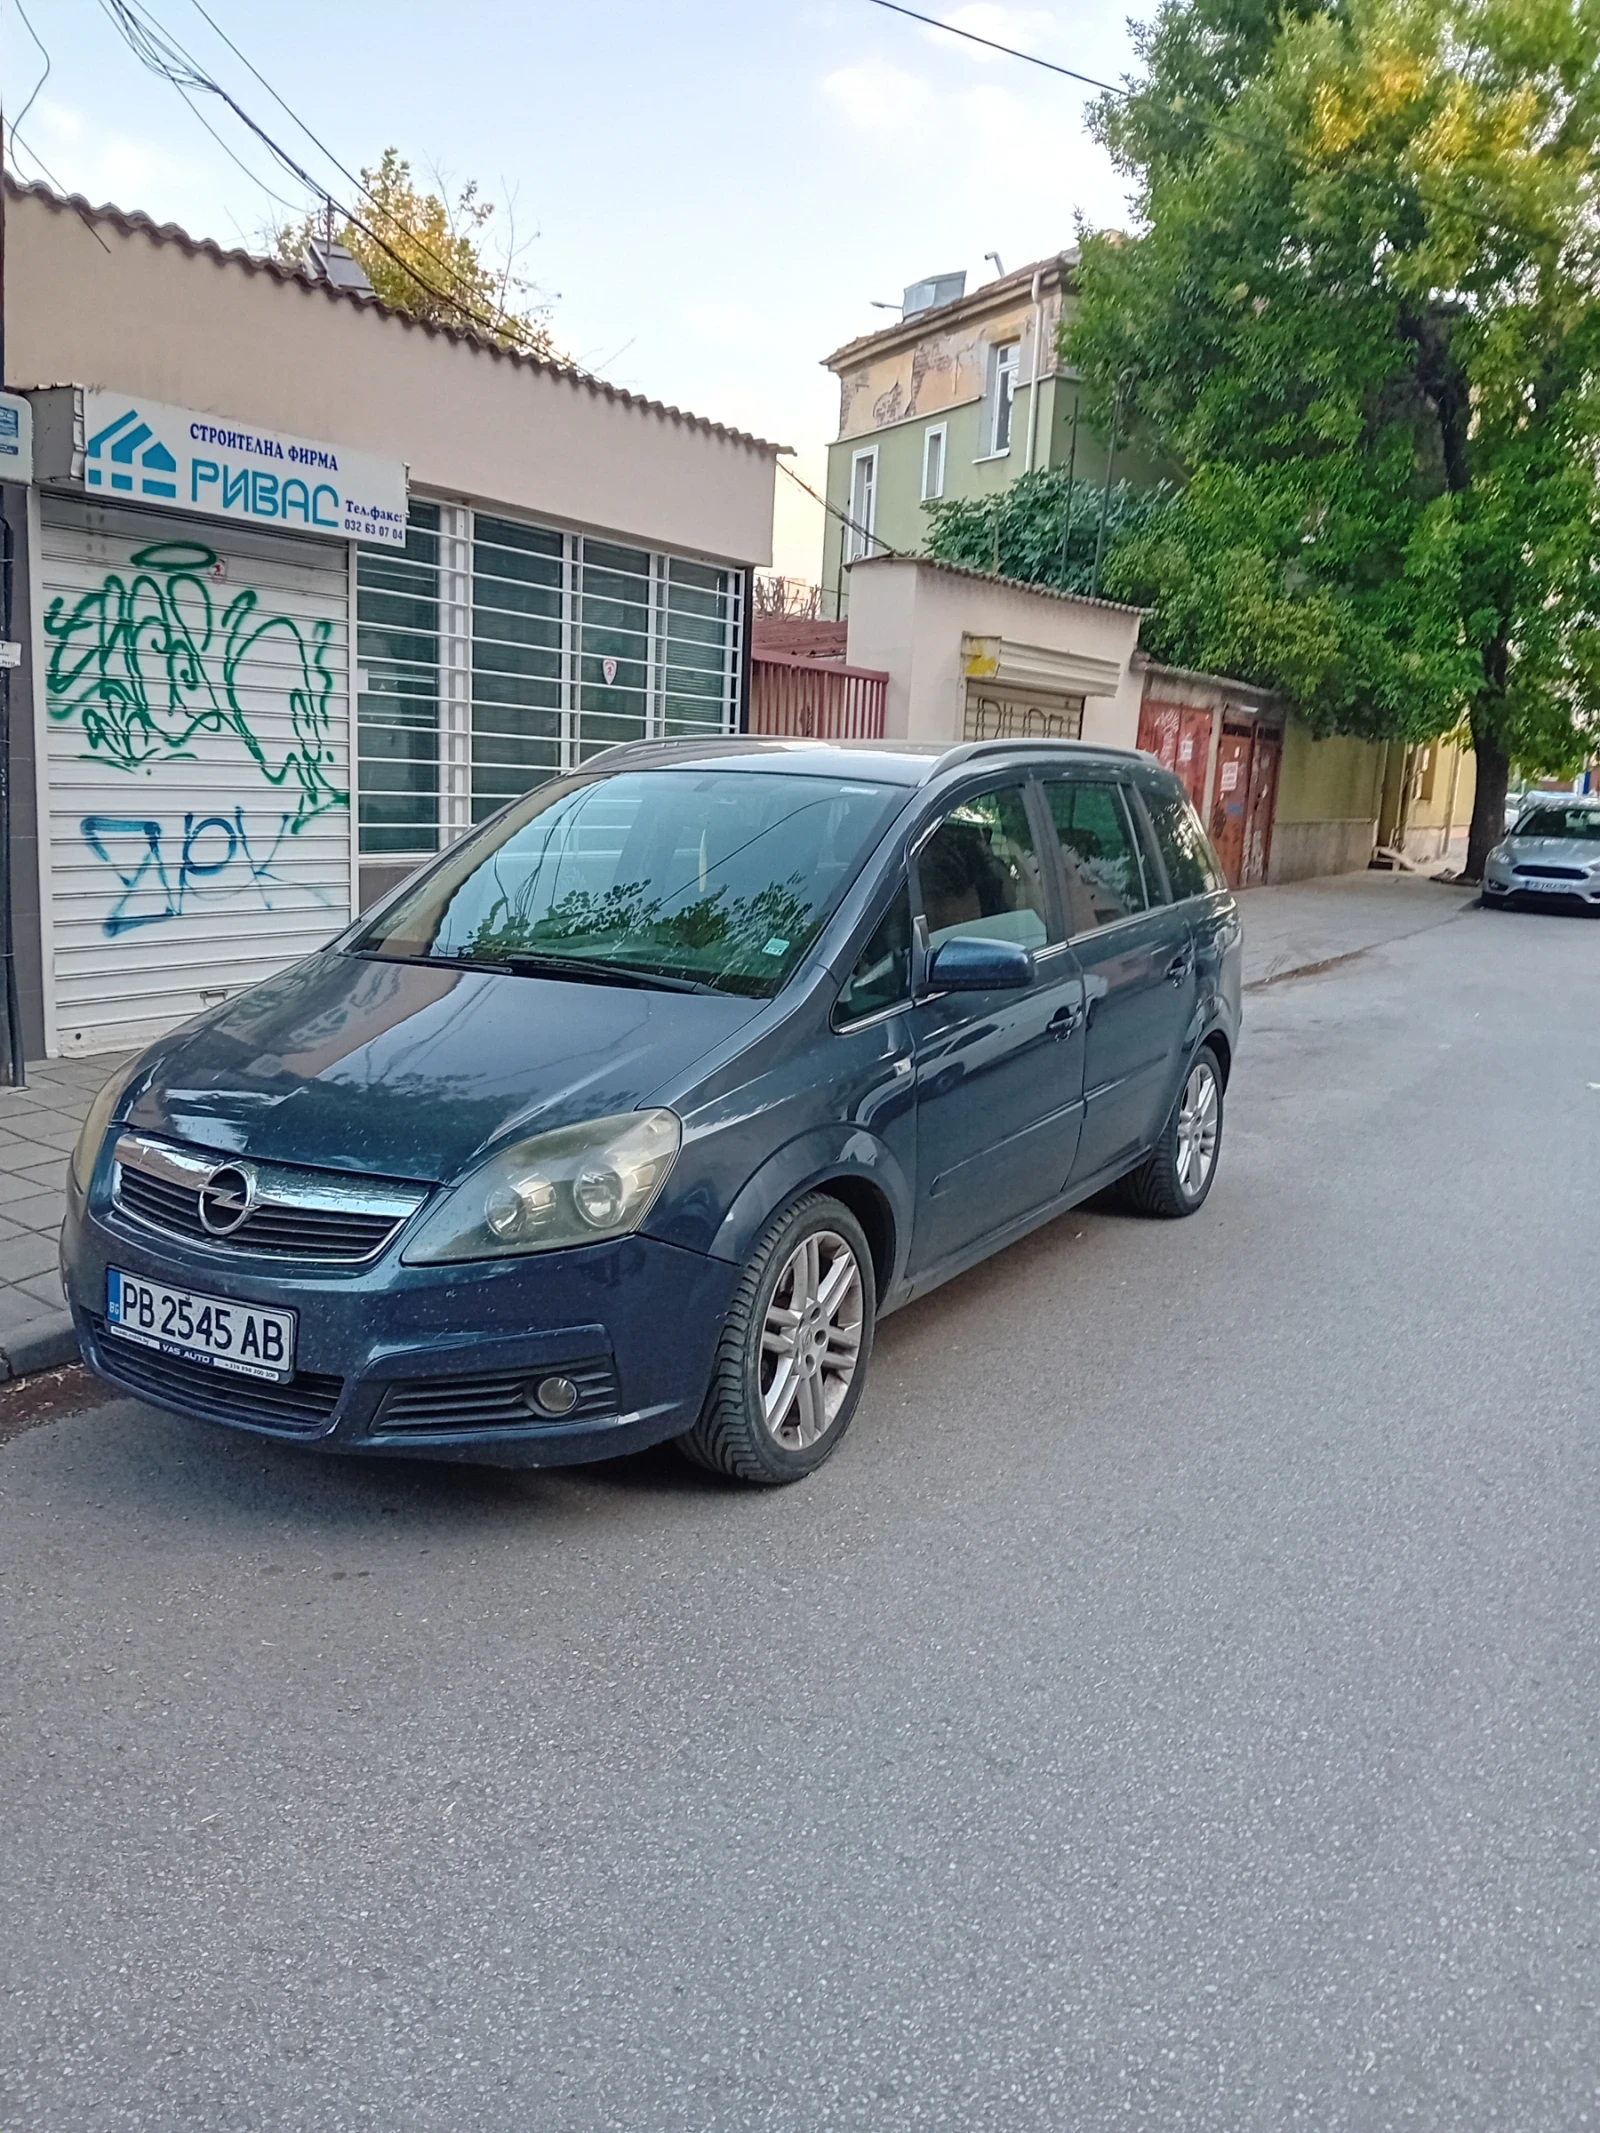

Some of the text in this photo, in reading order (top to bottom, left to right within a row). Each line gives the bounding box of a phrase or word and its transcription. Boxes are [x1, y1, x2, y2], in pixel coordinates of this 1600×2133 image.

[190, 423, 338, 471] СТРОИТЕЛНА ФИРМА
[191, 458, 339, 527] РИВАС
[345, 519, 403, 540] 032 63 07 04
[109, 1302, 120, 1315] BG
[123, 1281, 284, 1362] PB 2545 AB
[162, 1343, 210, 1364] VAS AUTO
